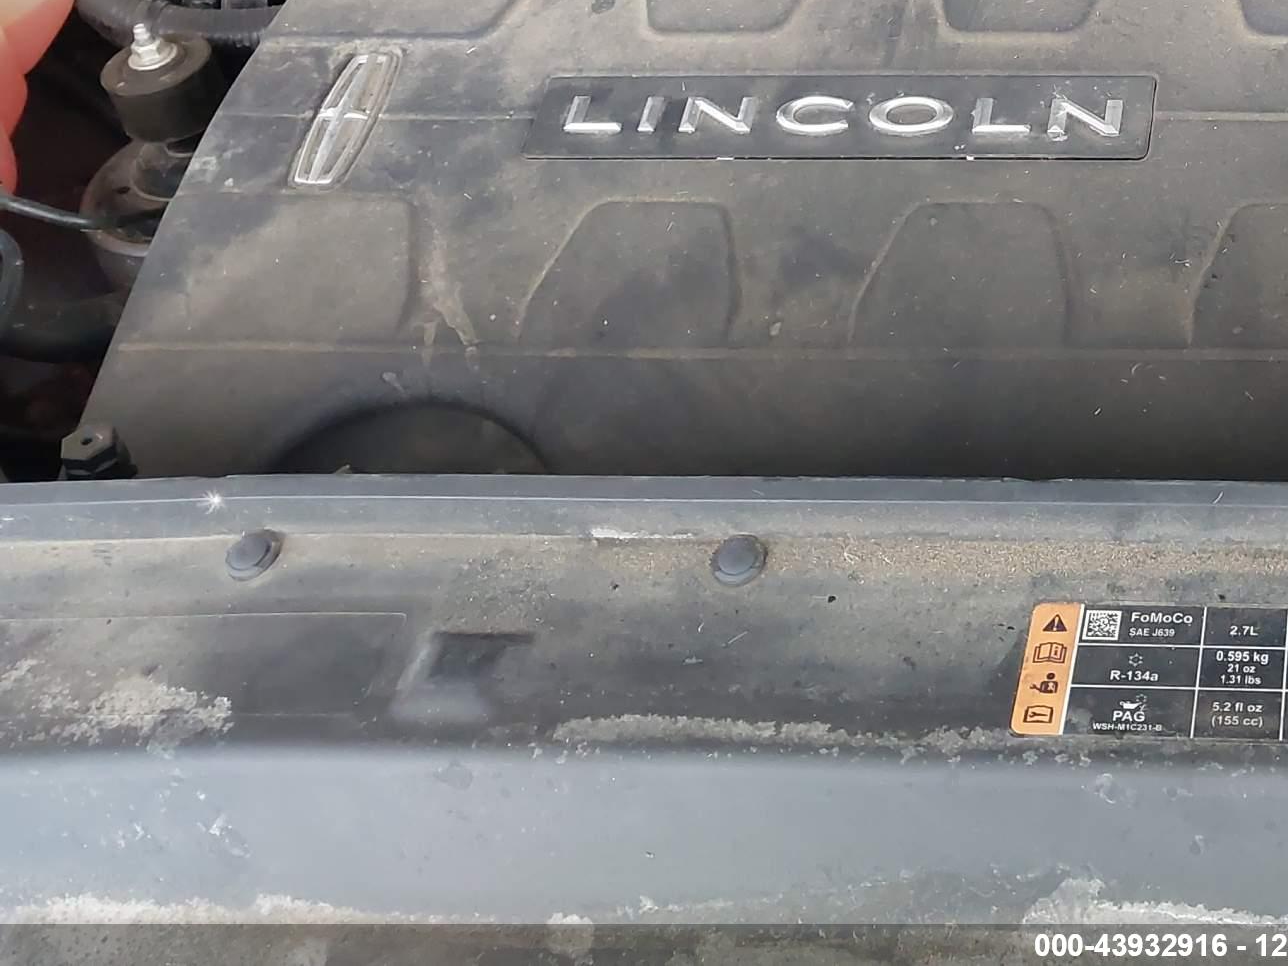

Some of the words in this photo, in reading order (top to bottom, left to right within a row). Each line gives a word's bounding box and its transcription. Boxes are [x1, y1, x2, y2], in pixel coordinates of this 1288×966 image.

[562, 95, 1125, 136] LINCOLN
[1131, 611, 1193, 624] FoMoCo
[1128, 627, 1150, 637] SAE
[1152, 628, 1176, 637] J639
[1229, 625, 1259, 637] 2.7L
[1216, 650, 1250, 662] 0.595
[1253, 651, 1269, 665] kg
[1227, 664, 1241, 673] 21
[1242, 665, 1256, 673] oz
[1109, 670, 1159, 682] R-134a
[1220, 675, 1242, 684] 1.31
[1244, 675, 1262, 685] lbs
[1212, 702, 1231, 712] 5.2
[1234, 702, 1244, 712] fl
[1247, 703, 1263, 713] oz
[1112, 710, 1146, 722] PAG
[1211, 716, 1239, 727] (155
[1242, 716, 1263, 728] cc)
